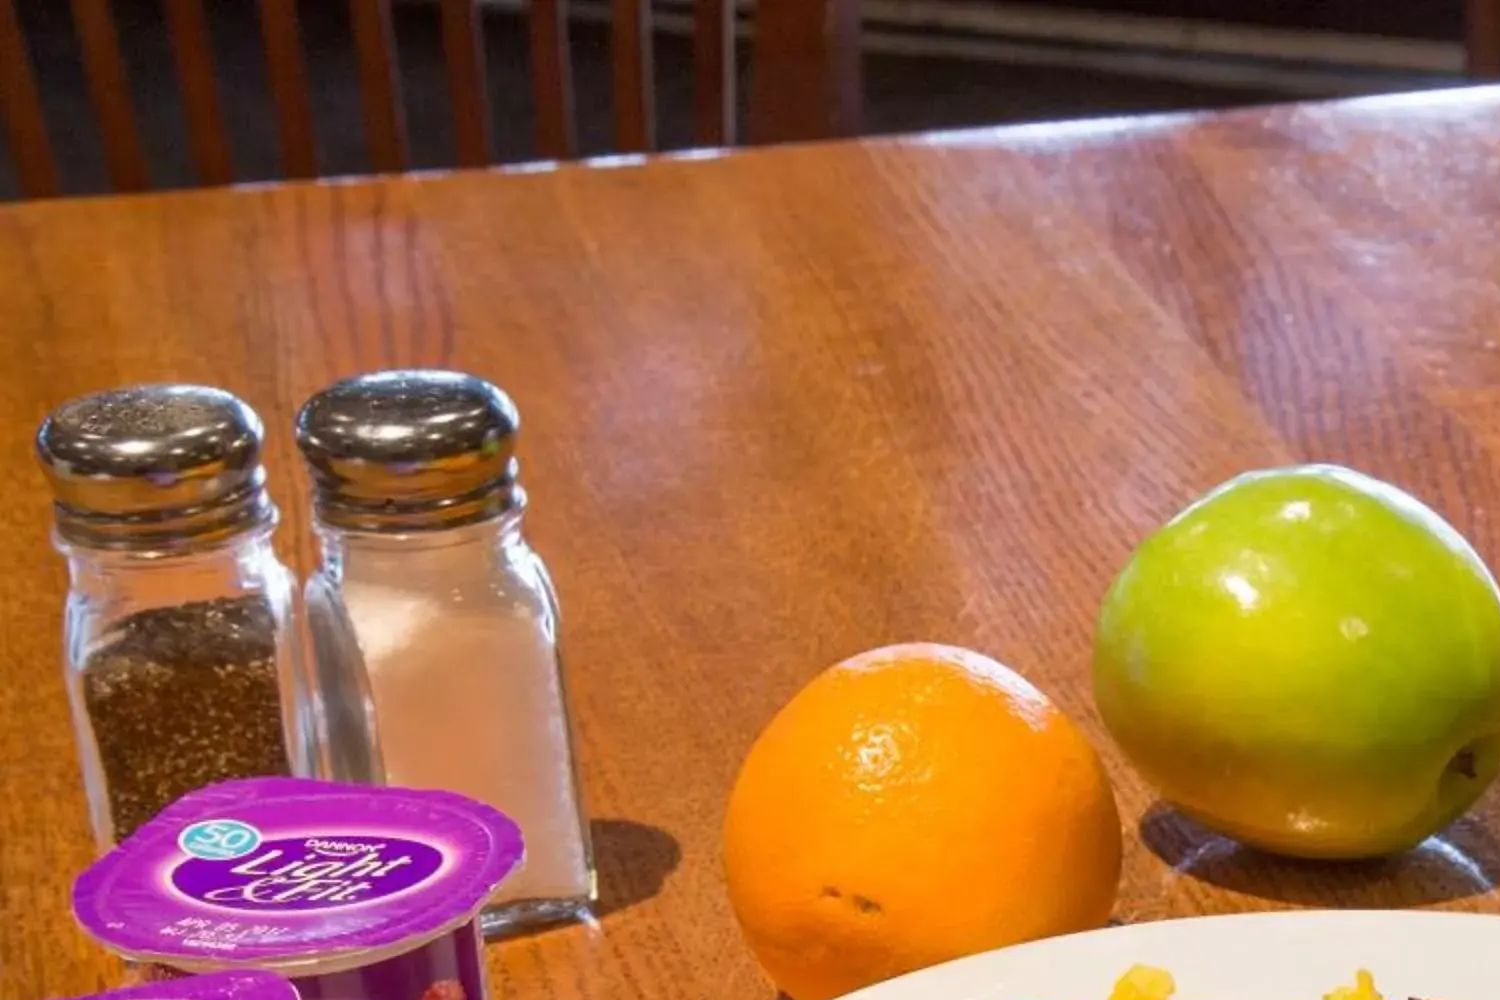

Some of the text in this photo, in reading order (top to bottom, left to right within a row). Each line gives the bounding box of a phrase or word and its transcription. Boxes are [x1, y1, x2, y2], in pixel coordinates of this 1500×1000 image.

[195, 824, 252, 848] 50
[304, 839, 382, 852] DANNON
[229, 849, 412, 886] Light
